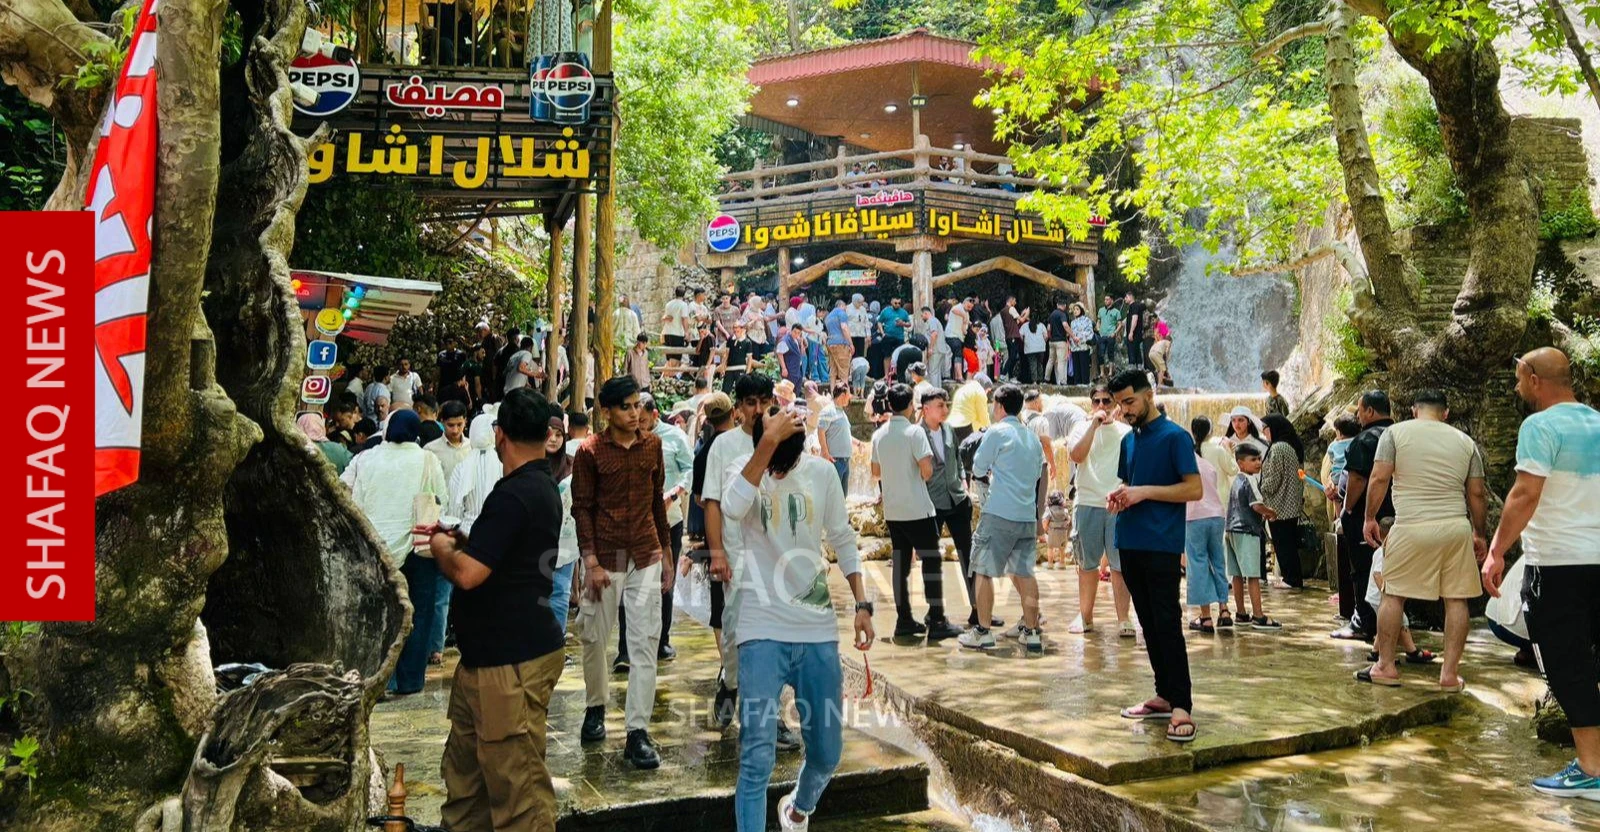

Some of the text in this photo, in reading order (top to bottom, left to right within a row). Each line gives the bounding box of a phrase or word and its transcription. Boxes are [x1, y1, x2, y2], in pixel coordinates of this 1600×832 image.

[288, 71, 355, 88] PEPSI
[547, 80, 592, 92] PEPSI
[307, 123, 591, 189] شلال اشاو
[708, 226, 738, 239] PEPSI
[1006, 216, 1064, 245] شلال
